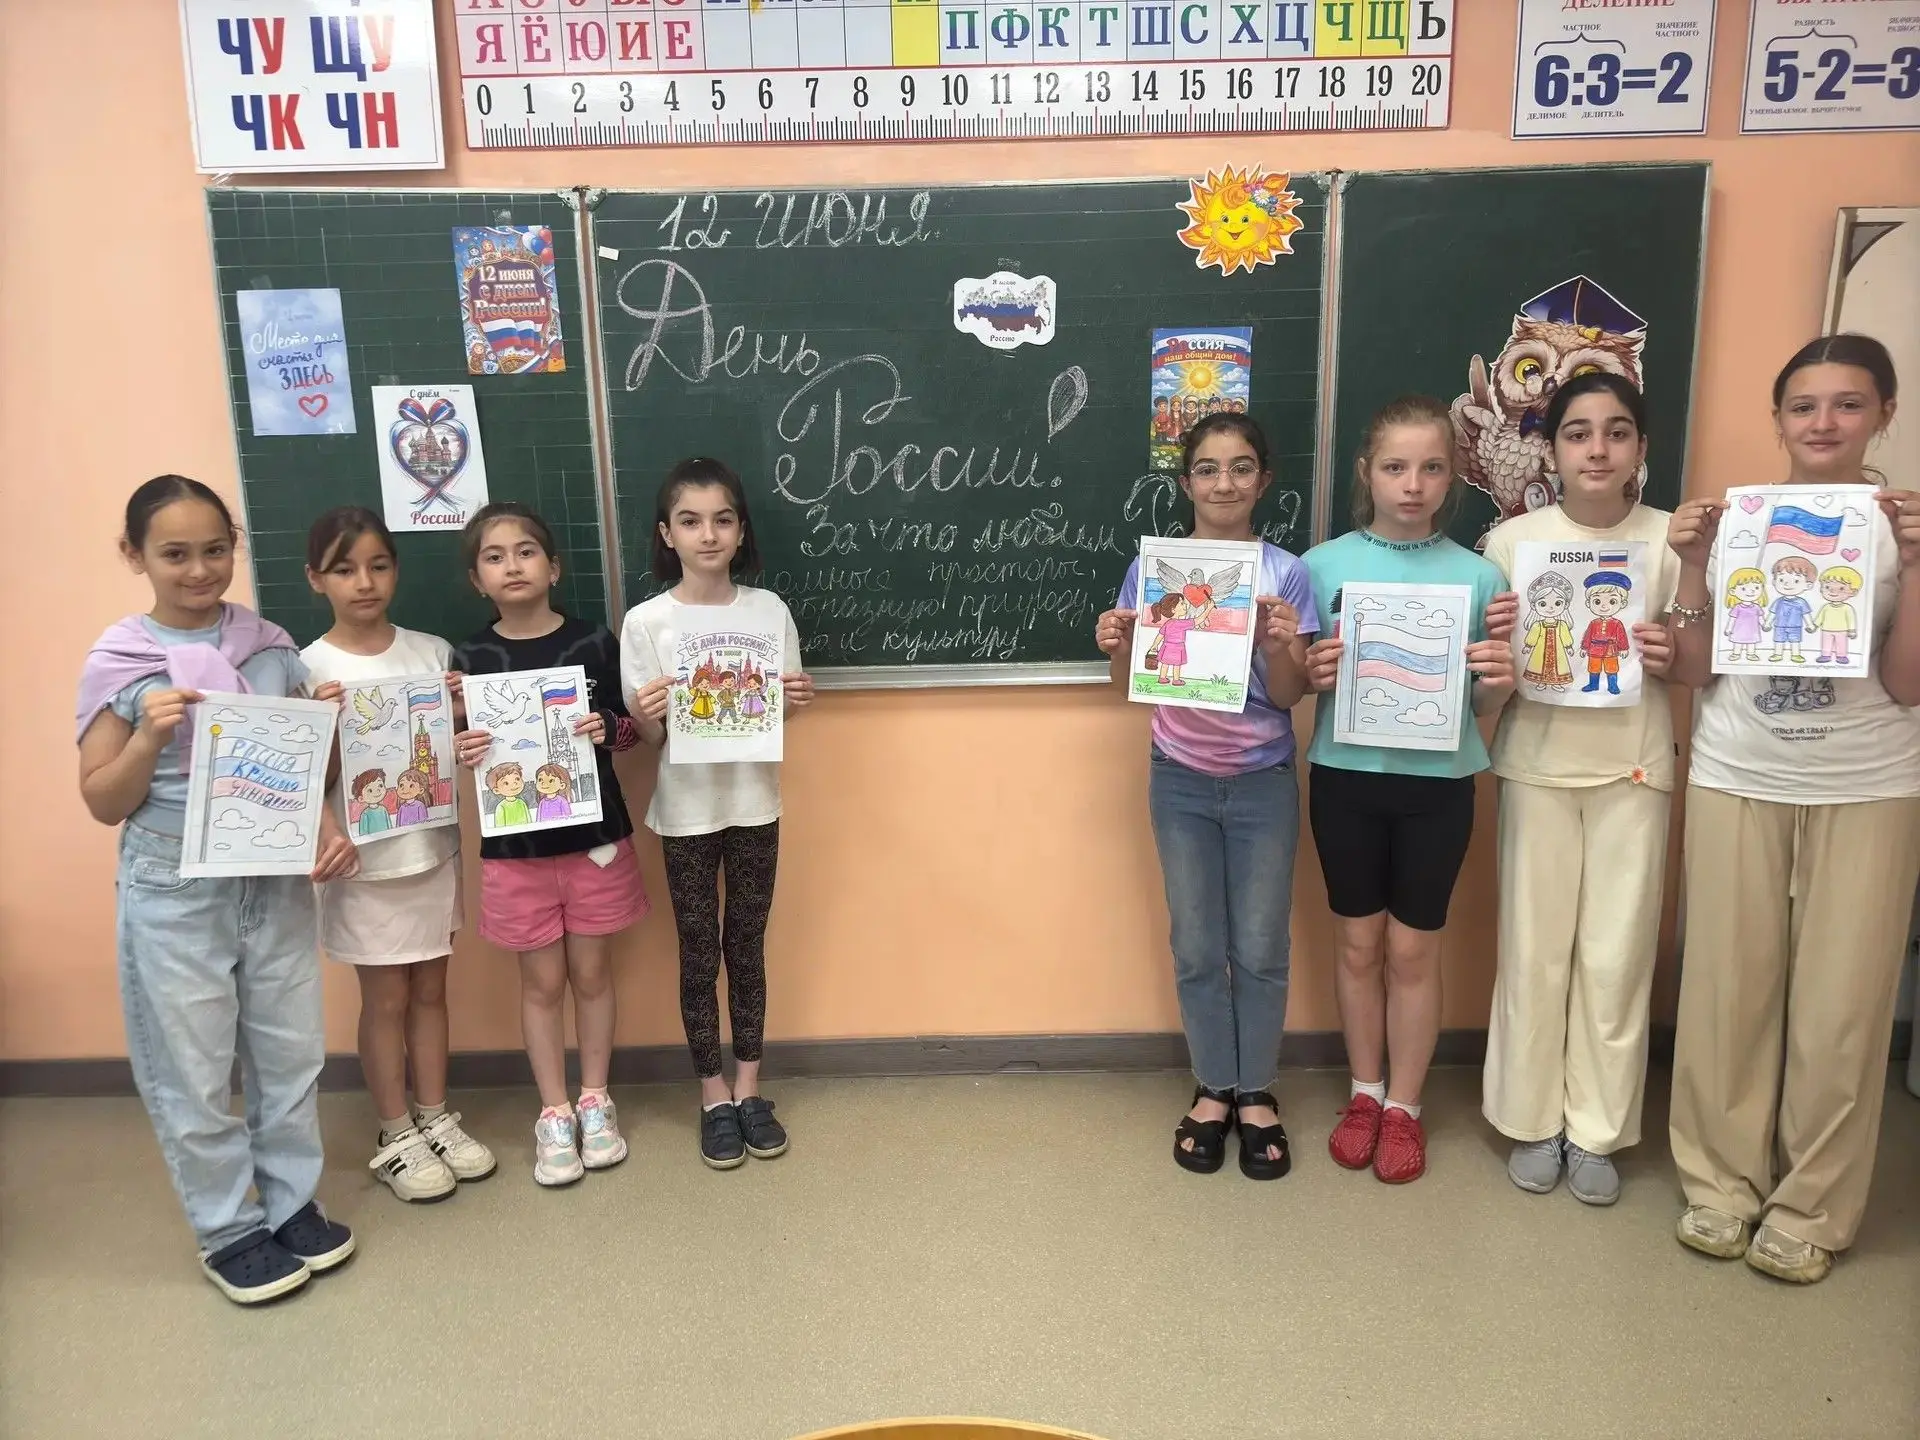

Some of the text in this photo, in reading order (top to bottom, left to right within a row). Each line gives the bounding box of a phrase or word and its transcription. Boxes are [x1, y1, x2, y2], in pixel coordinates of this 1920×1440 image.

[217, 15, 395, 82] ЧУ ЩУ
[475, 1, 1446, 63] Я Ё Ю И Е П Ф К Т Ш С Х Ц Ч Щ Ь
[1655, 30, 1699, 38] ЧАСТНОГО
[477, 64, 1441, 115] 0 1 2 3 4 5 6 7 8 9 10 11 12 13 14 15 16 17 18 19 20
[1534, 52, 1692, 107] 6:3=2
[1764, 47, 1920, 102] 5-2=3
[231, 91, 399, 150] ЧК ЧН
[1527, 111, 1624, 121] ДЕЛИМОЕ ДЕЛИТЕЛЬ
[657, 195, 731, 251] 12
[479, 265, 496, 281] 12
[616, 259, 821, 391] День
[279, 364, 334, 390] ЗДЕСЬ
[1164, 351, 1236, 362] наш общий дом!
[410, 389, 416, 399] С
[411, 510, 466, 525] России!
[801, 503, 861, 557] За
[1550, 552, 1594, 563] RUSSIA
